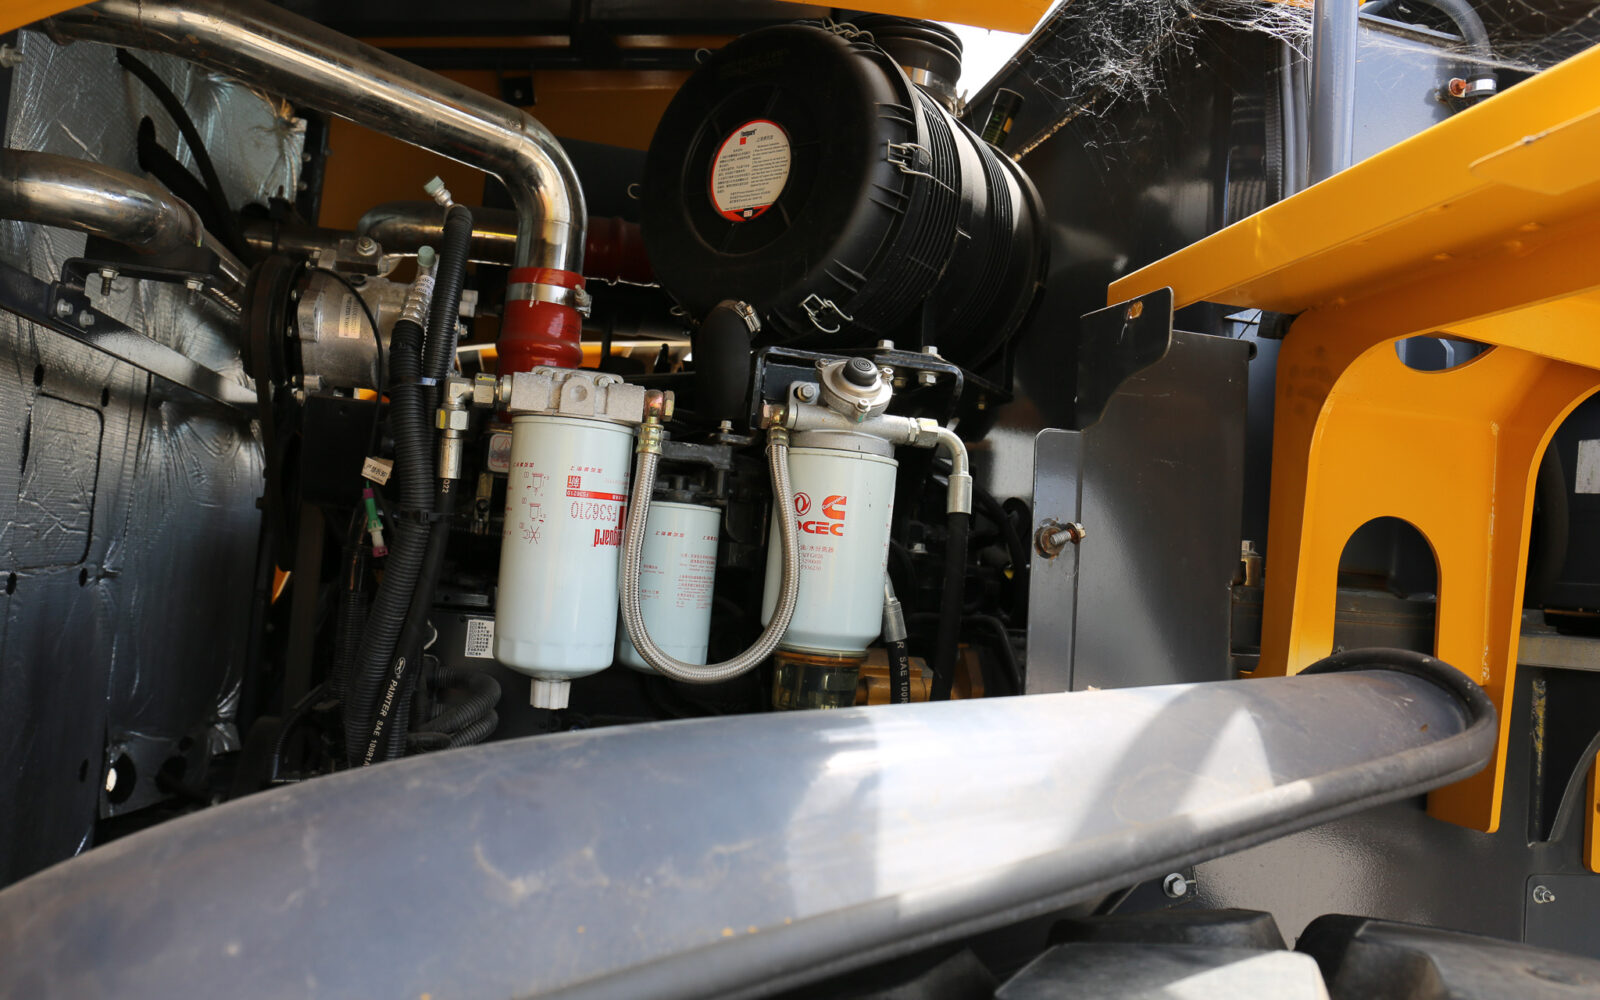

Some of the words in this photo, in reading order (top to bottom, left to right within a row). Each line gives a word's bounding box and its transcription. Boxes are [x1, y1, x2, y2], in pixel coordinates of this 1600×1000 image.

[899, 656, 908, 677] SAE
[379, 679, 398, 717] PAINTER
[372, 720, 384, 737] SAE
